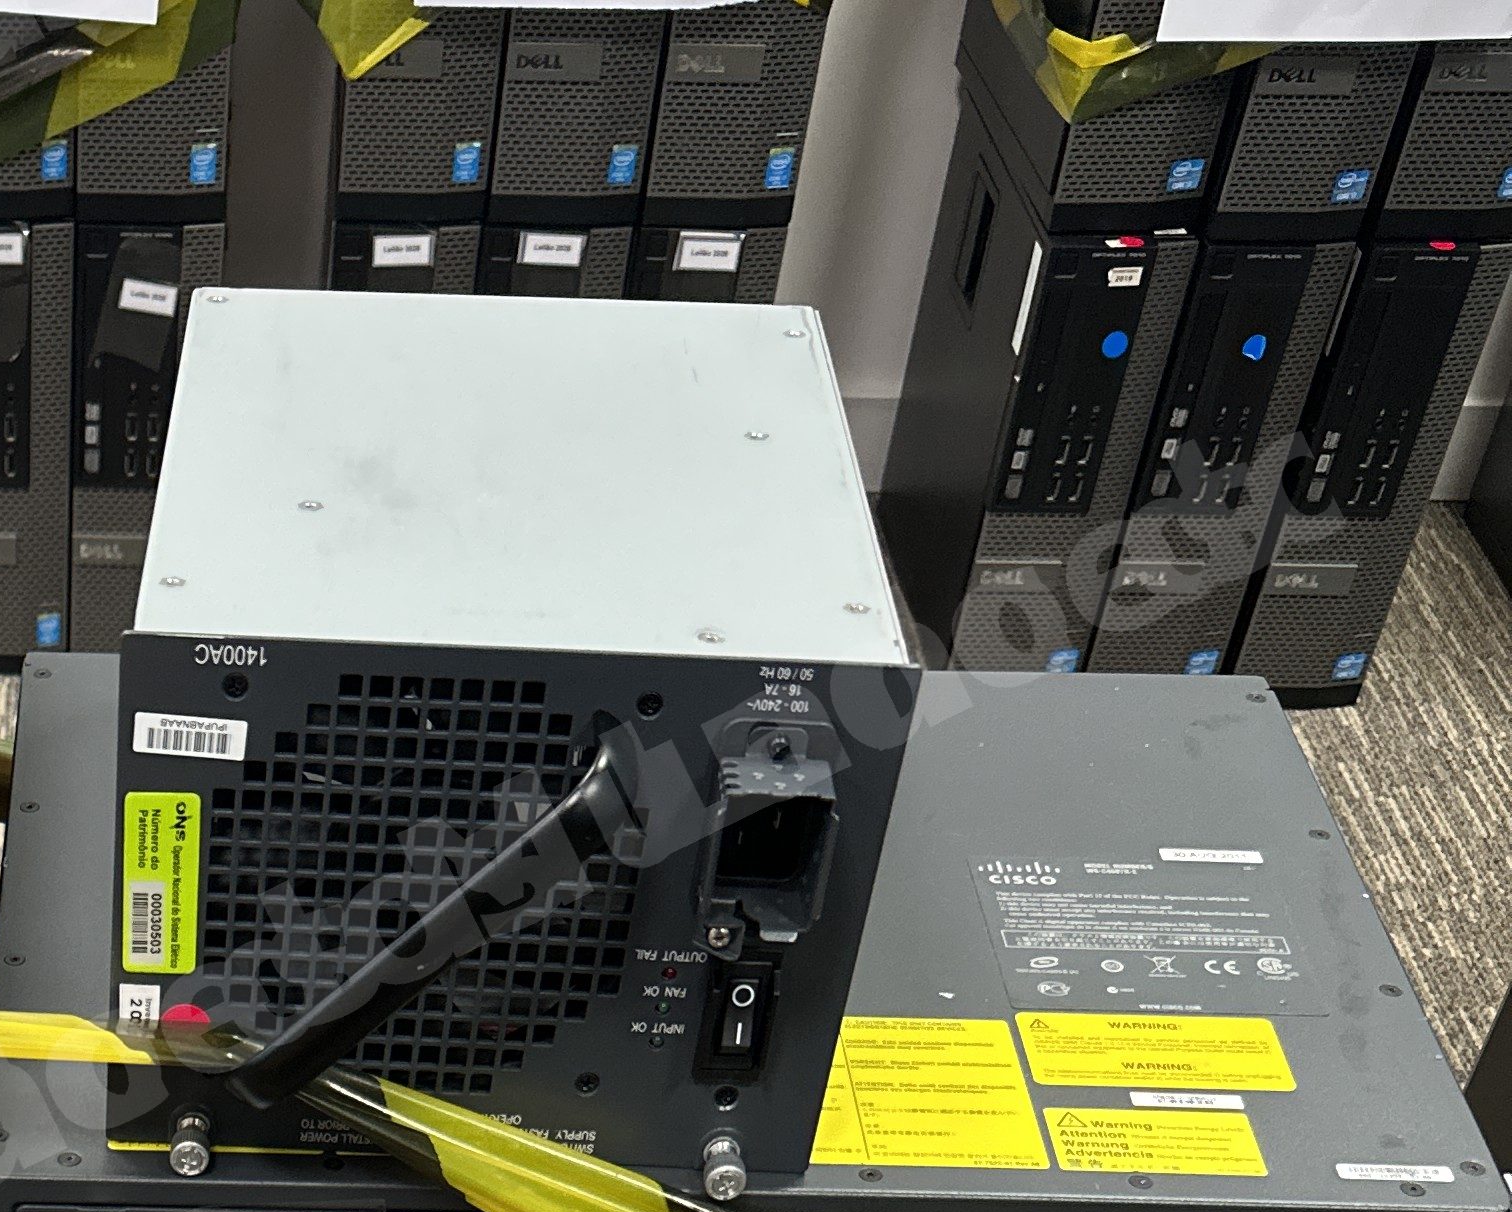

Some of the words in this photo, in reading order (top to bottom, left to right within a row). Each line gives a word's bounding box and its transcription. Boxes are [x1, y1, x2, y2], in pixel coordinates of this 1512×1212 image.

[516, 54, 563, 70] DELL
[1269, 67, 1316, 83] DELL
[194, 643, 268, 666] 1400AC
[759, 666, 776, 680] Hz
[777, 667, 791, 681] 60
[799, 666, 815, 681] 50
[790, 699, 809, 713] 100
[149, 893, 163, 955] 00030503
[635, 949, 658, 962] FAIL
[661, 951, 708, 963] OUTPUT
[642, 985, 660, 997] OK
[664, 986, 687, 998] FAN
[630, 1021, 648, 1033] OK
[650, 1022, 685, 1035] INPUT
[1090, 1120, 1153, 1132] Warning
[1059, 1129, 1127, 1140] Attention
[1060, 1140, 1130, 1152] Warnung
